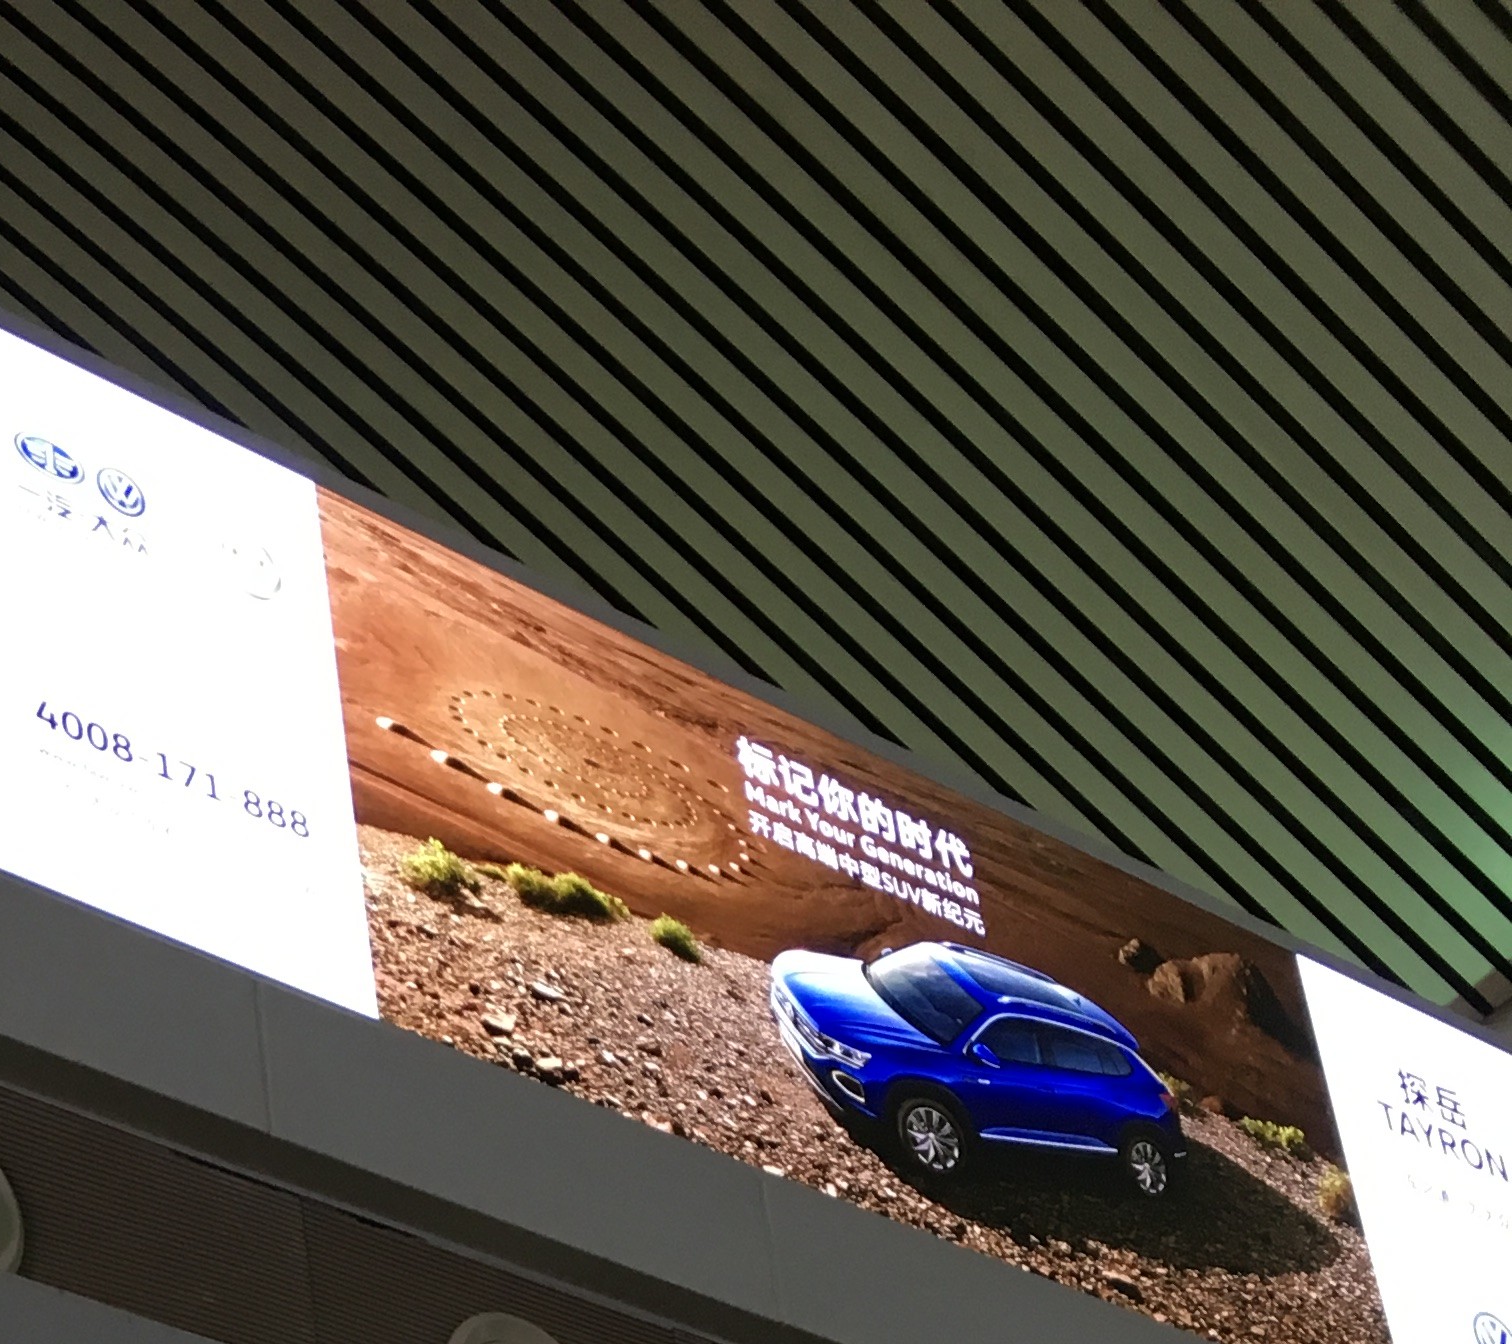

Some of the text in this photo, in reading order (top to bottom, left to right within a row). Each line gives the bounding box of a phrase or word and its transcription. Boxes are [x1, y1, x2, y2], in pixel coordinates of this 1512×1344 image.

[735, 735, 974, 879] 标记你的时代
[745, 781, 980, 905] Mark Your Generation
[1377, 1100, 1509, 1182] TAYRON
[1399, 1068, 1468, 1131] 探岳
